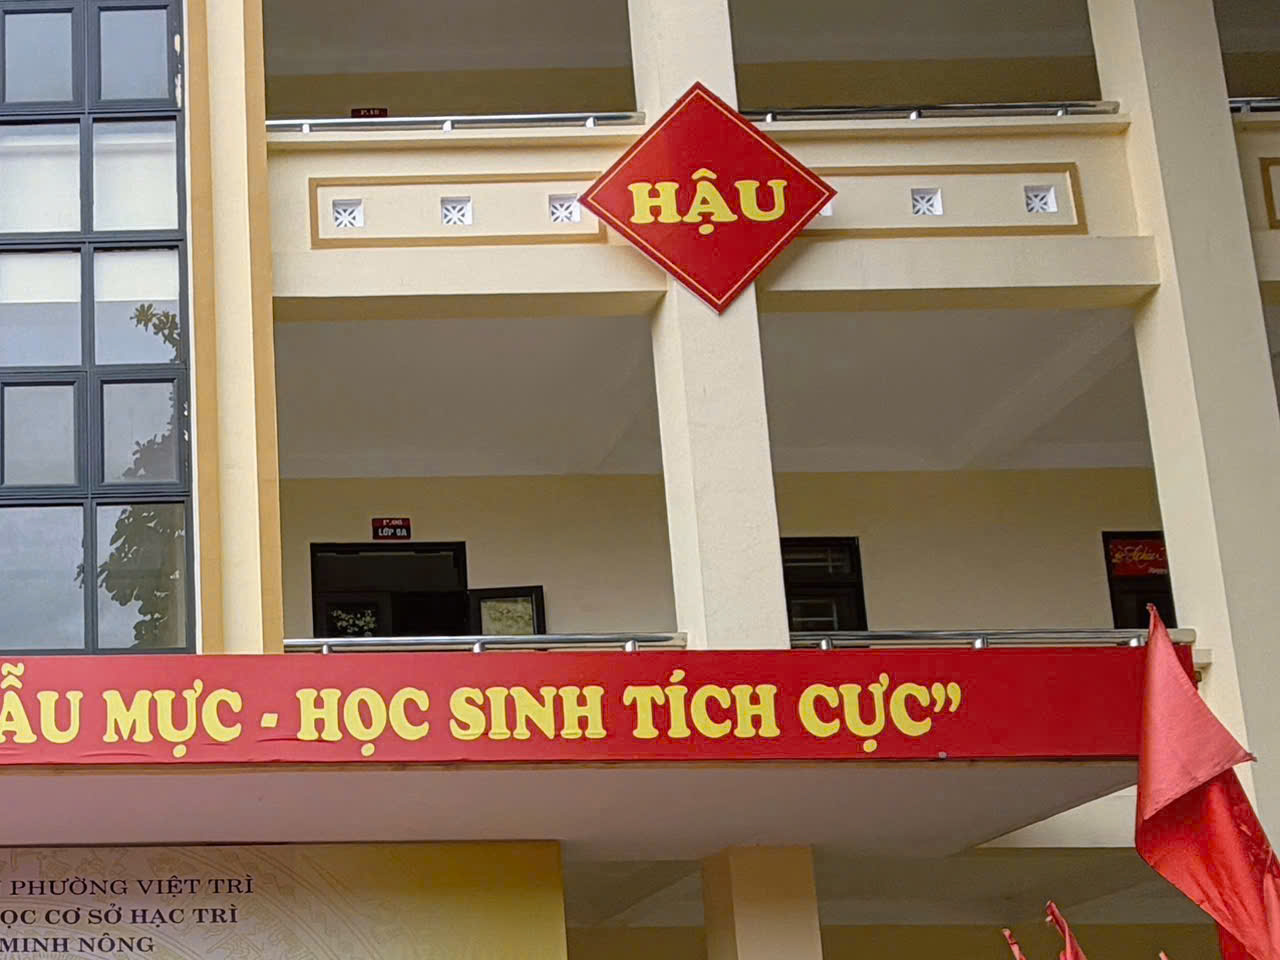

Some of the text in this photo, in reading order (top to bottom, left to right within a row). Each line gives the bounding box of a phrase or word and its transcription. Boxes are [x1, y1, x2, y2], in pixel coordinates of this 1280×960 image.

[628, 168, 787, 236] HẬU
[103, 679, 242, 757] MỰC
[261, 713, 277, 728] -
[296, 687, 430, 756] HỌC
[449, 687, 607, 740] SINH
[624, 670, 779, 739] TÍCH
[799, 673, 962, 753] CỰC”
[10, 878, 128, 896] PHƯỜNG
[137, 875, 200, 898] VIỆT
[208, 878, 255, 894] TRÌ
[44, 908, 81, 925] CƠ
[87, 903, 123, 925] SỞ
[130, 908, 185, 928] HẠC
[192, 904, 238, 924] TRÌ
[0, 937, 70, 953] MINH
[78, 933, 154, 953] NÔNG
